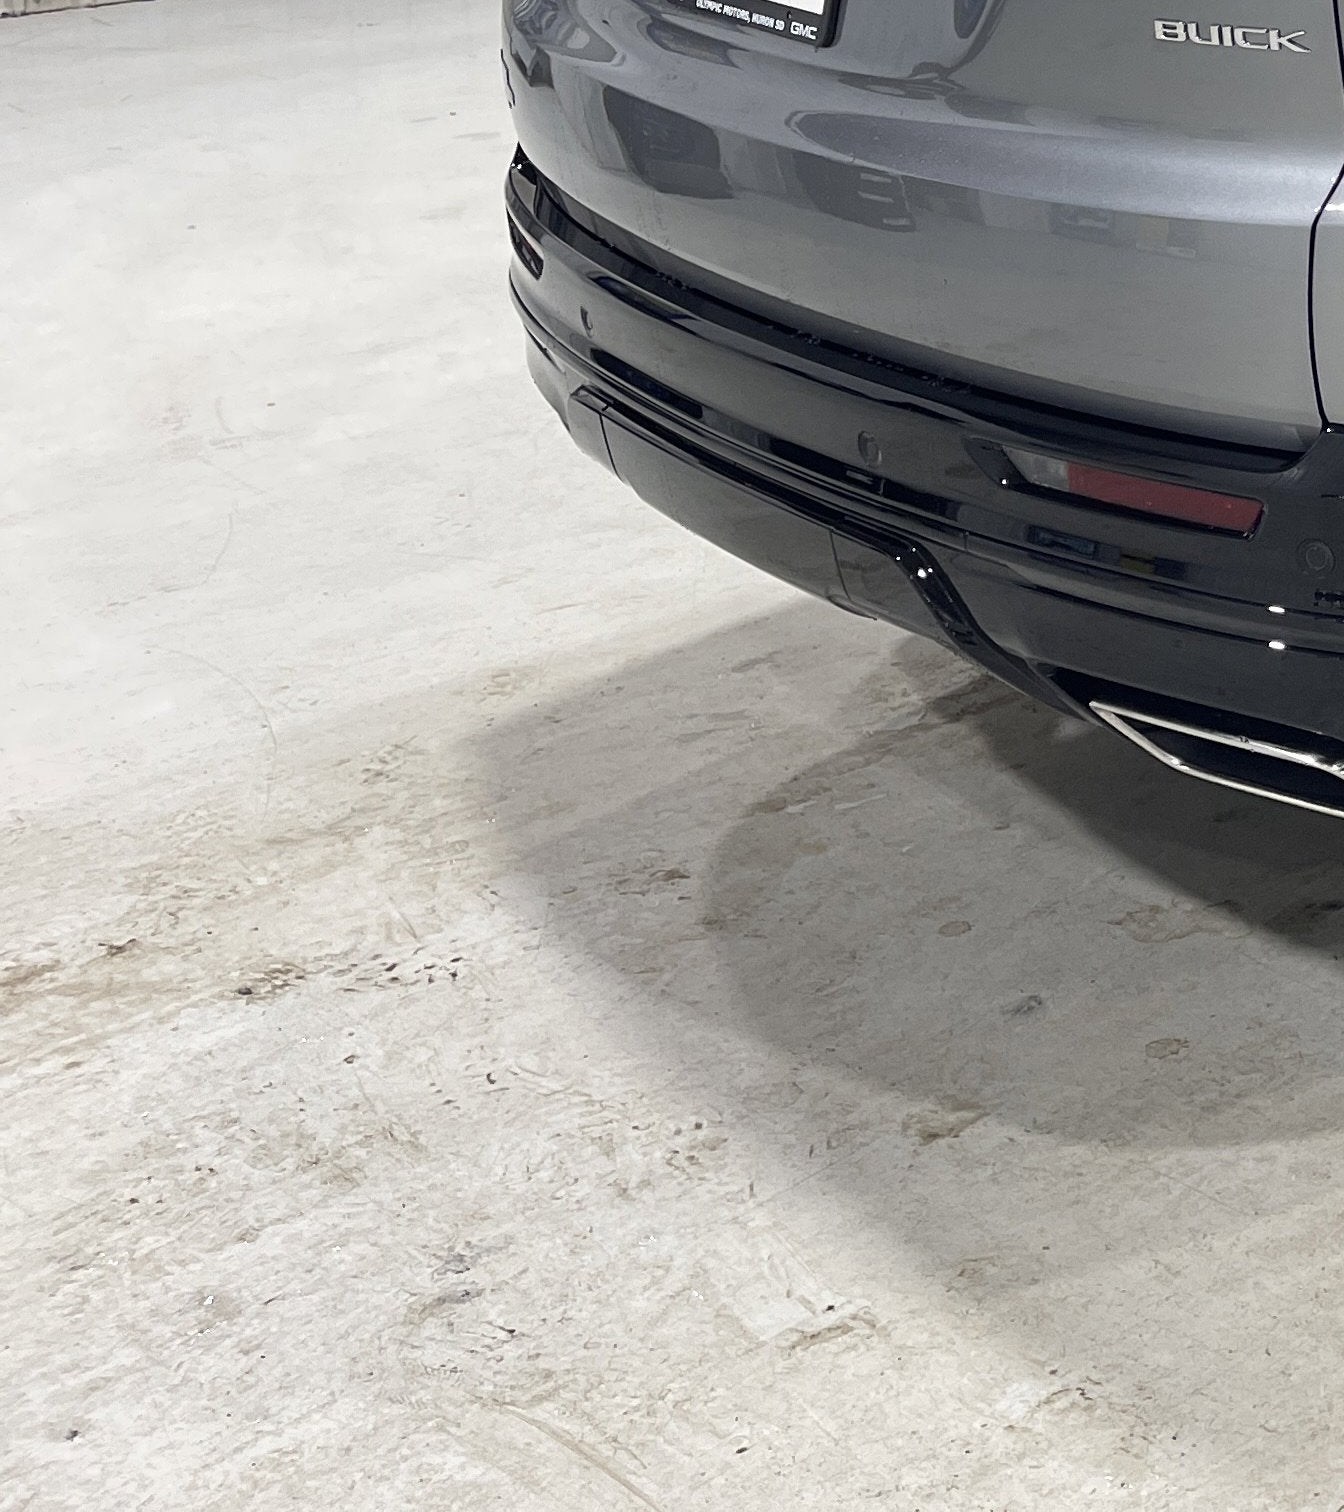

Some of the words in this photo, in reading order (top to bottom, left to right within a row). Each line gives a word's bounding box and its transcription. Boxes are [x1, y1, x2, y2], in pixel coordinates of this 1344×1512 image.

[751, 12, 775, 29] HURON
[774, 19, 785, 31] SD
[790, 21, 818, 40] GMC
[1154, 18, 1312, 54] BUICK
